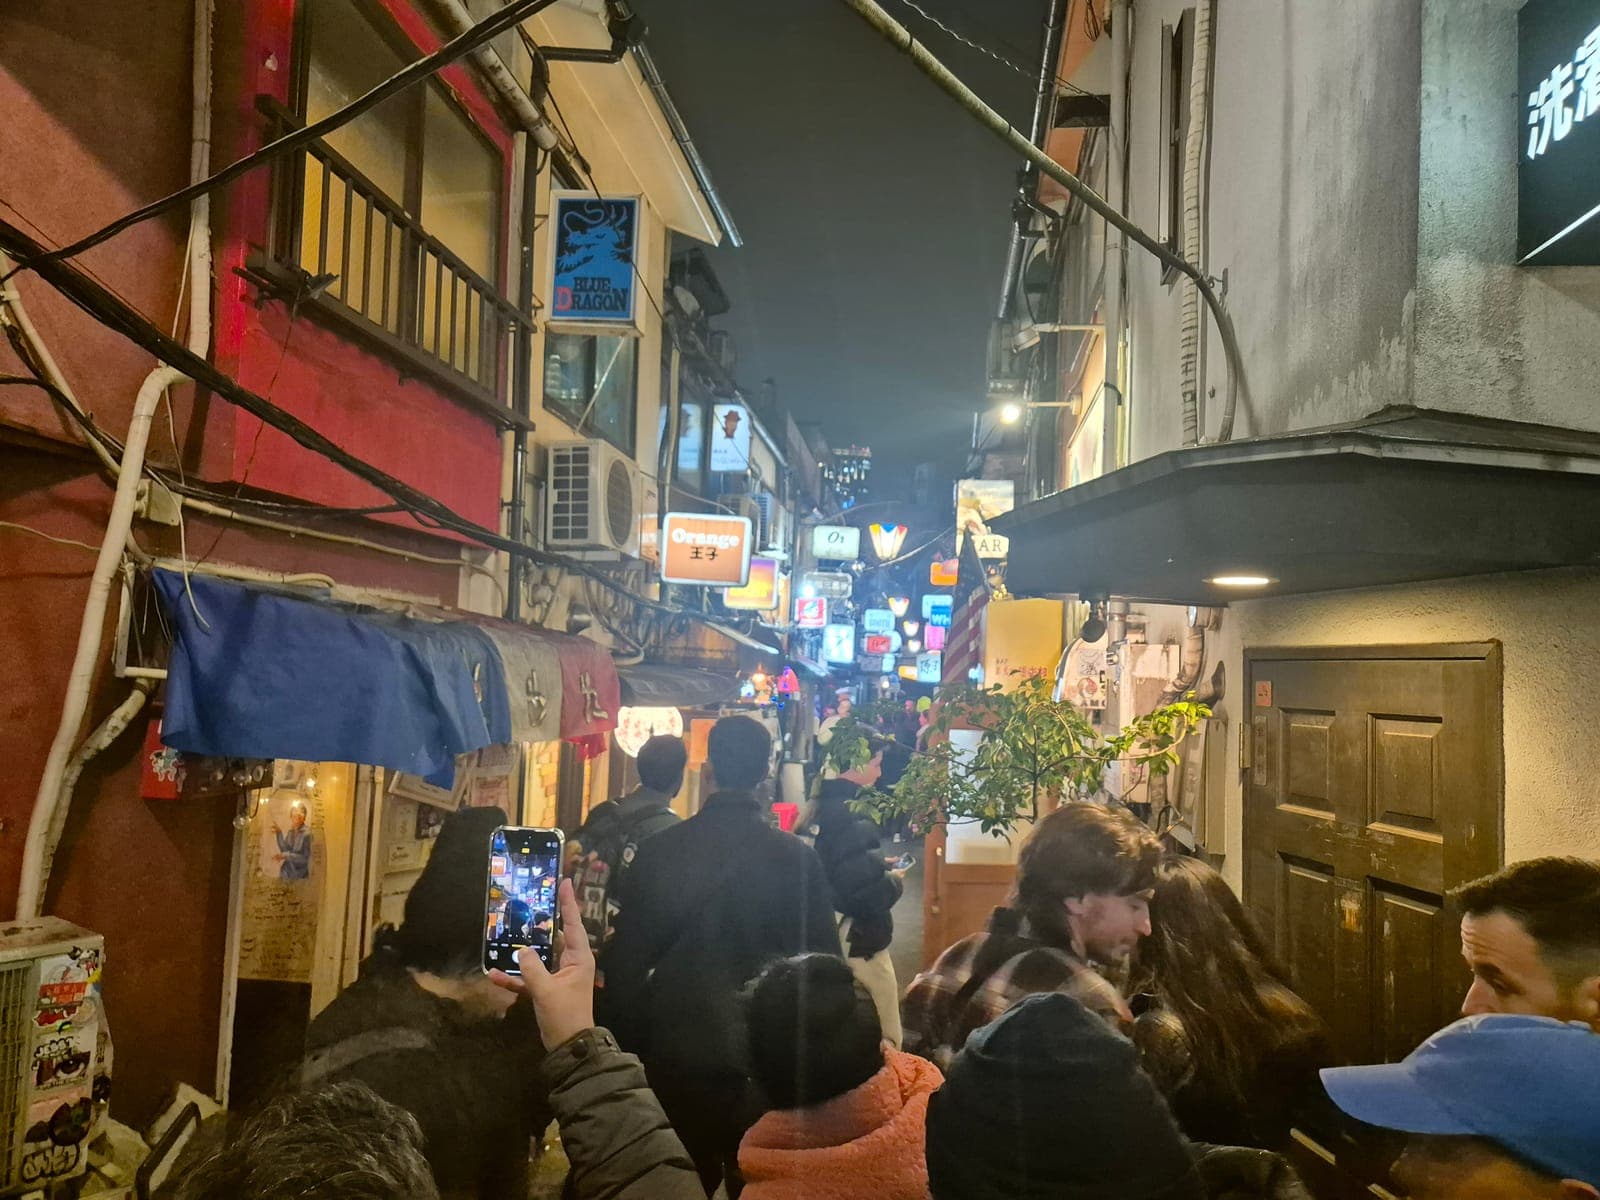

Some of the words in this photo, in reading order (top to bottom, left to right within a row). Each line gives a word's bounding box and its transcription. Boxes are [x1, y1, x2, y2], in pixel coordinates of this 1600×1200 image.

[574, 277, 611, 292] BLUE
[556, 286, 628, 311] DRAGON
[672, 528, 740, 549] Orange
[689, 546, 718, 561] 王子
